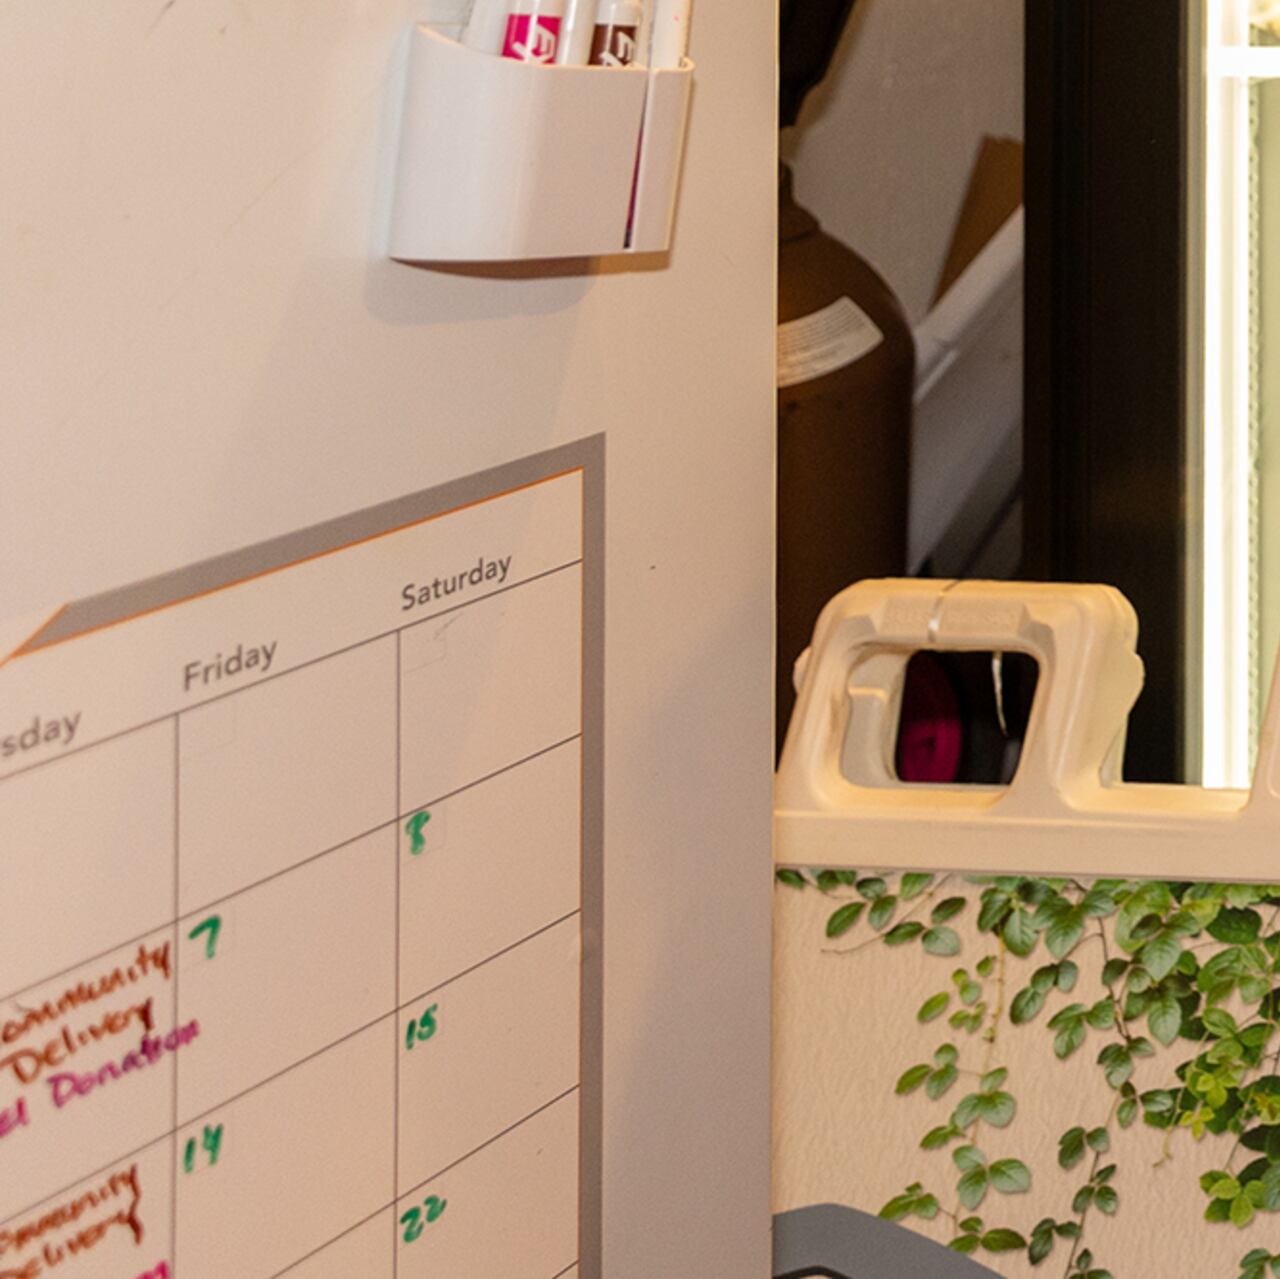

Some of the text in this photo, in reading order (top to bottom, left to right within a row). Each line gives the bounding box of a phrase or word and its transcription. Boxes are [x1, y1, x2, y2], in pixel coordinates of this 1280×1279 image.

[401, 552, 512, 612] Saturday
[183, 641, 278, 692] Friday
[189, 914, 221, 959] 7
[405, 1003, 438, 1050] 15
[184, 1123, 224, 1173] 14
[400, 1194, 446, 1243] 22
